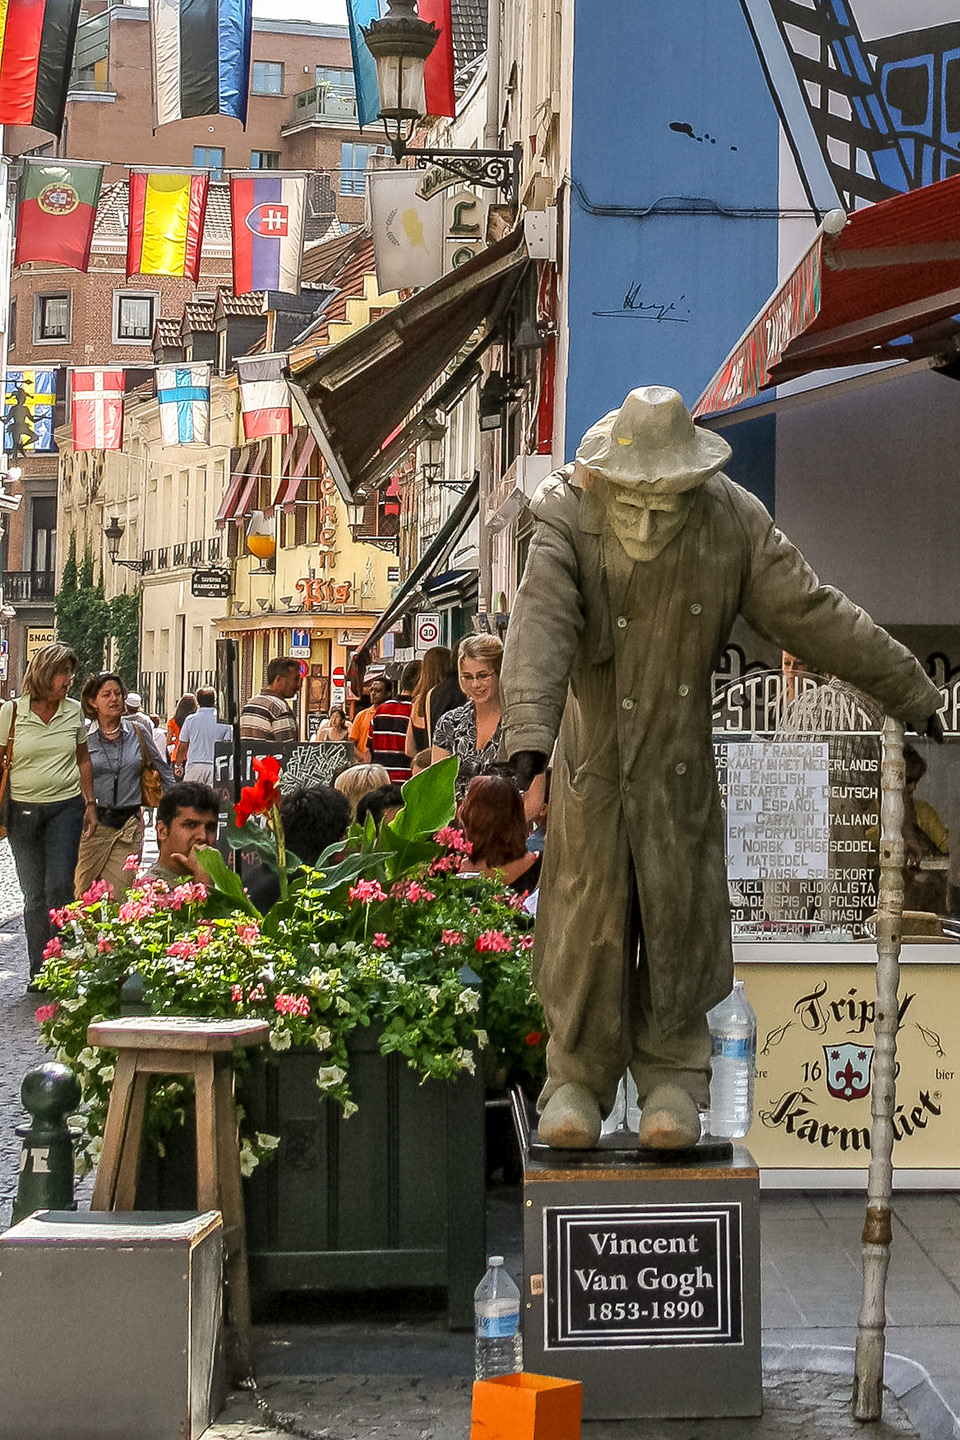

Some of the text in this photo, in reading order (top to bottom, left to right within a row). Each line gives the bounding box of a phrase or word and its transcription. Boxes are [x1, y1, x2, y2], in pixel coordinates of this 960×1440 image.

[423, 629, 434, 637] 30
[802, 756, 879, 772] NEDERLANDS
[751, 770, 806, 785] ENGLISH
[794, 785, 817, 798] AUF
[822, 784, 879, 799] DEUTSCH
[735, 799, 752, 811] EN
[822, 812, 879, 827] ITALIANO
[807, 867, 875, 881] SPISEKORT
[799, 881, 875, 894] RUOKALISTA
[806, 895, 822, 908] PO
[828, 895, 877, 908] POLSKU
[813, 909, 863, 921] ARIMASU
[794, 979, 916, 1035] Tripl
[935, 1068, 955, 1080] bier
[758, 1087, 942, 1151] Karmliet
[588, 1232, 700, 1256] Vincent
[574, 1265, 714, 1297] Van Gogh
[588, 1300, 704, 1322] 1853-1890
